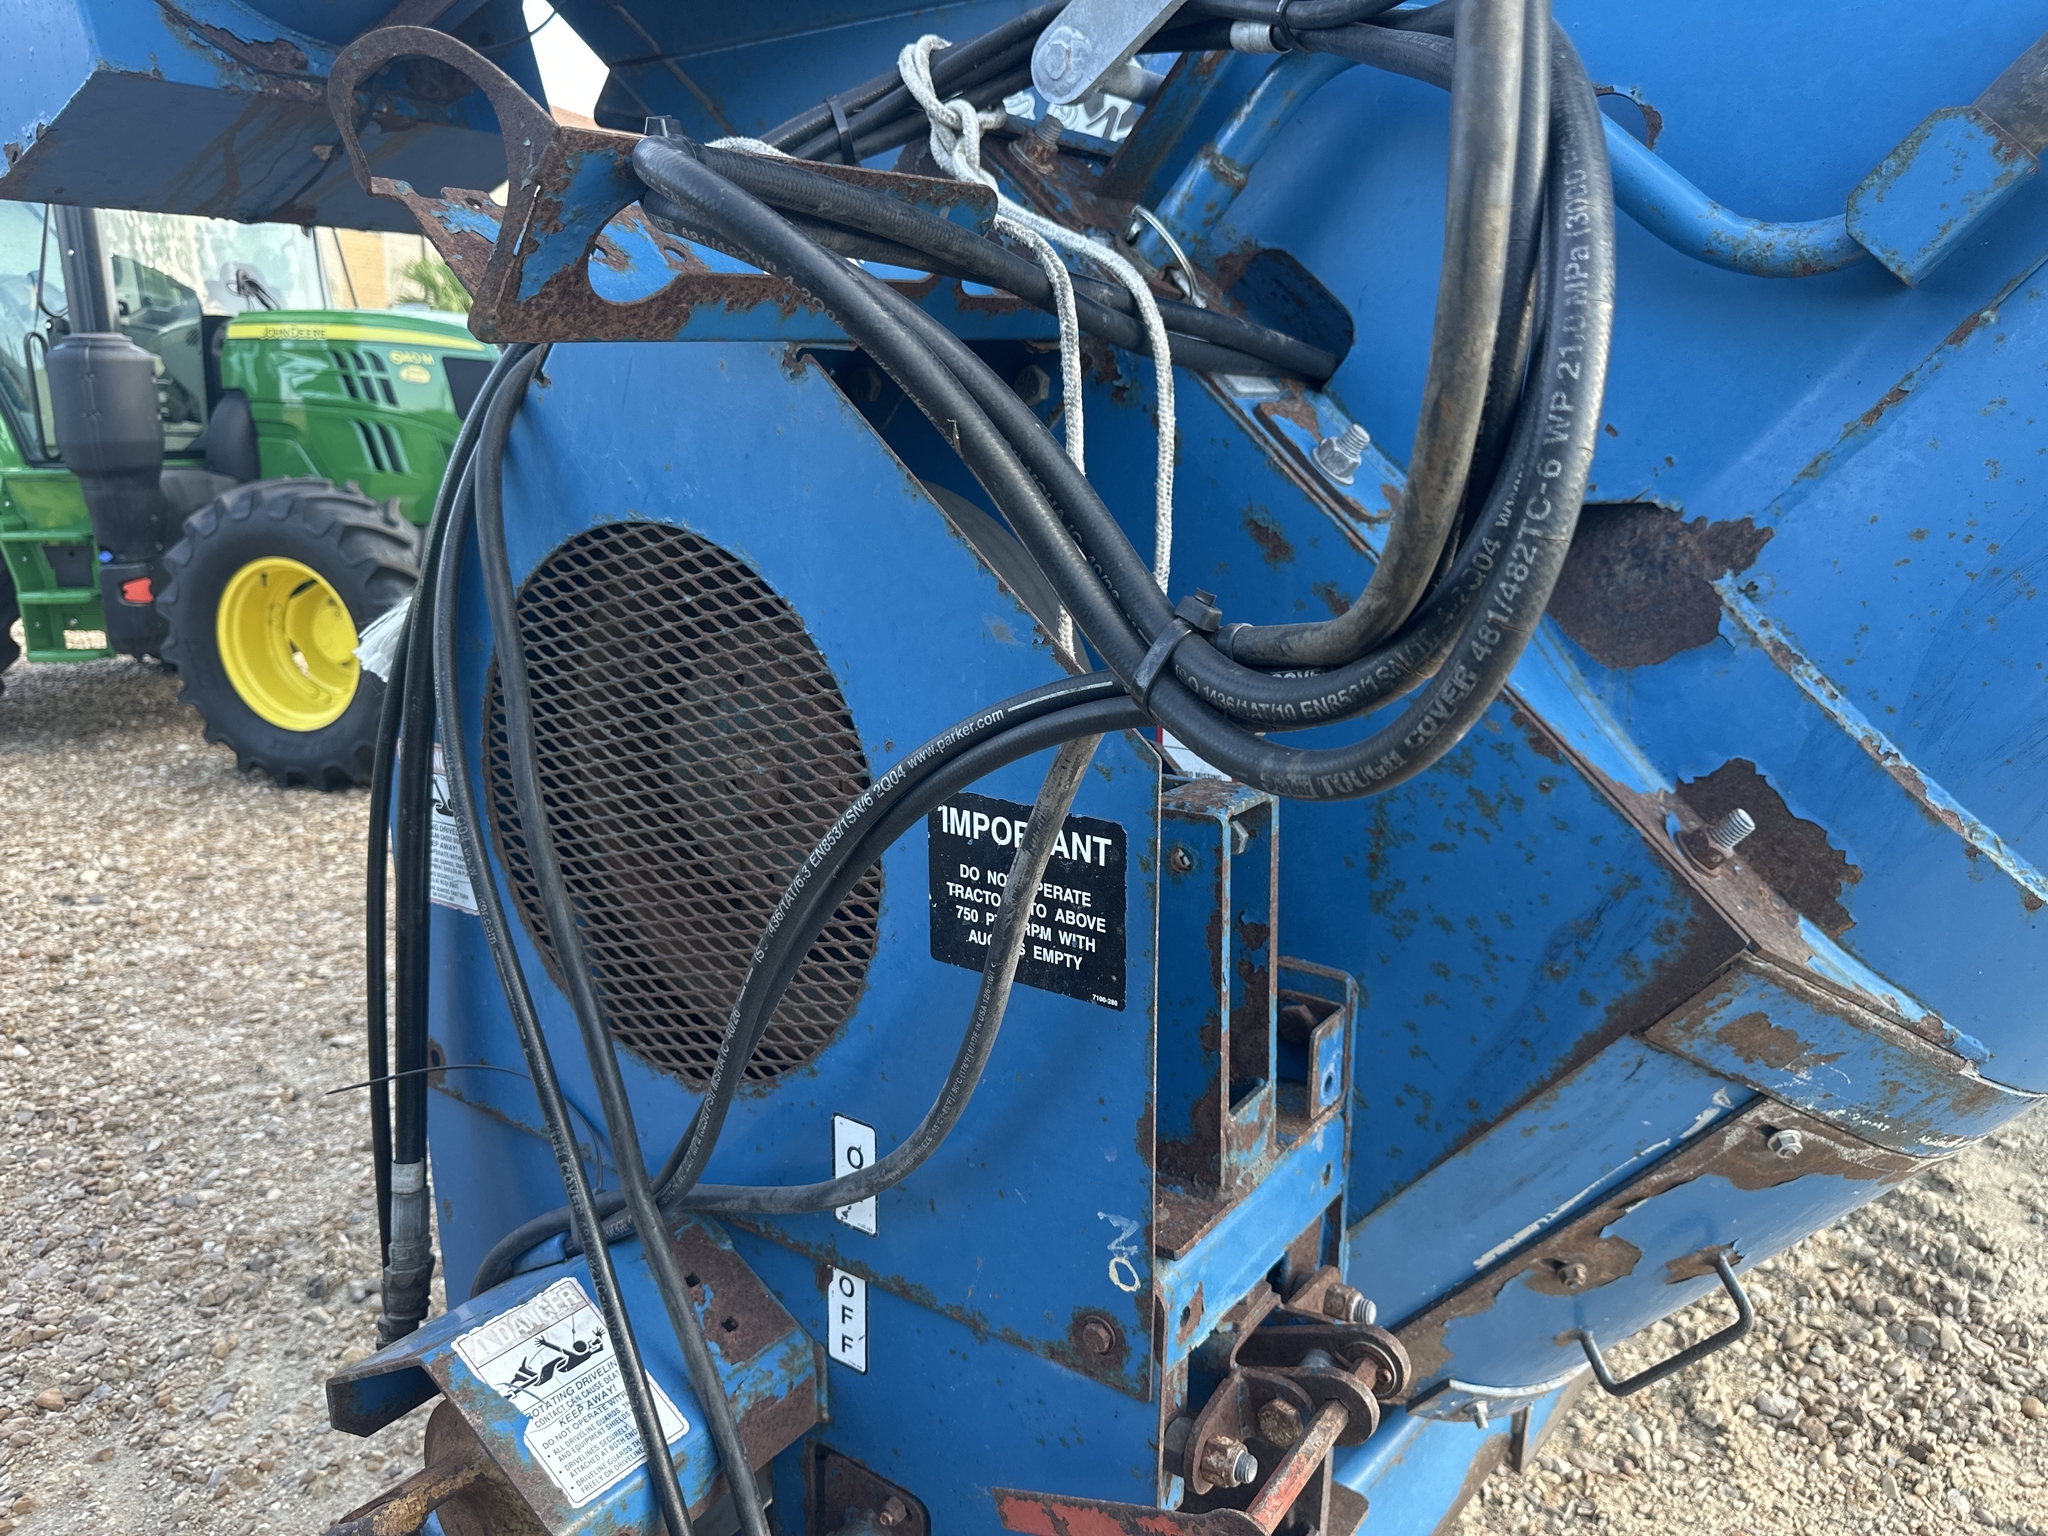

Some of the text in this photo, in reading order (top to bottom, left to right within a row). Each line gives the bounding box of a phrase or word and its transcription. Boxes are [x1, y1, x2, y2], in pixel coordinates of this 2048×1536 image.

[1404, 664, 1477, 750] COVER
[1543, 391, 1572, 446] WP
[1564, 244, 1591, 307] MPa
[872, 764, 907, 799] 2Q04
[907, 708, 1005, 770] www.parker.com
[941, 805, 1112, 867] IMPOANT
[946, 882, 1107, 933] TRACTO TO ABOVE
[959, 864, 1092, 908] DO NO PERATE
[955, 905, 979, 923] 750
[1058, 931, 1097, 953] WITH
[1033, 945, 1083, 971] EMPTY
[967, 1031, 980, 1055] MADE
[978, 1004, 988, 1022] USA
[495, 1287, 578, 1342] DANGER
[838, 1275, 855, 1353] OFF
[534, 1370, 621, 1429] CONTACT CAN CAUSE DEAT
[575, 1359, 618, 1391] DRIVELIN
[542, 1438, 555, 1450] DO
[554, 1426, 572, 1441] NOT
[572, 1403, 609, 1430] OPERATE
[608, 1389, 628, 1406] WITH
[558, 1383, 618, 1427] KEEP AWAY!
[553, 1445, 566, 1456] ALL
[564, 1423, 596, 1449] DRIVELINE
[558, 1410, 631, 1463] AND EQUIPMENT SHIELDS
[564, 1424, 630, 1472] DRIVELINES SECURELY
[569, 1428, 639, 1478] ATTACHED AT BOTH END
[575, 1463, 608, 1487] DRIVELINE
[607, 1445, 633, 1466] GUARDS
[580, 1477, 604, 1494] FREELY
[604, 1468, 615, 1479] ON
